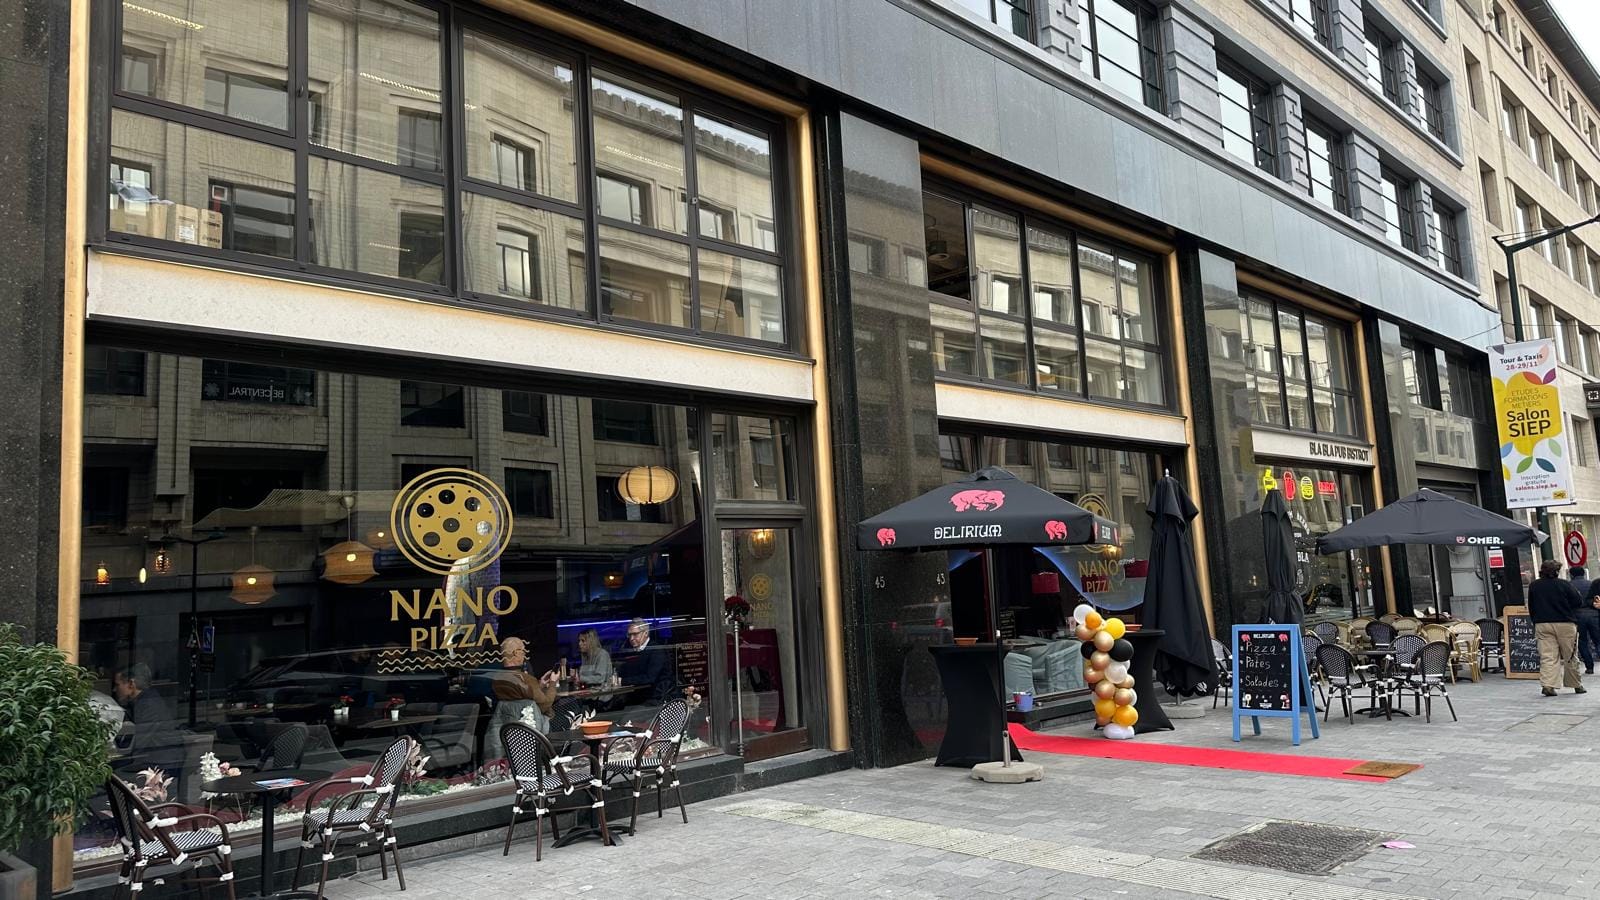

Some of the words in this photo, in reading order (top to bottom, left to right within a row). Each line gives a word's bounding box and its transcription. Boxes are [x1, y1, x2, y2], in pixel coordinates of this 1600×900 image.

[1524, 353, 1543, 361] Taxis
[1506, 361, 1538, 370] 28-29/11
[1504, 393, 1549, 404] FORMATIONS
[1506, 408, 1550, 422] Salon
[1508, 420, 1551, 438] SIEP
[1309, 442, 1322, 455] BLA
[1322, 443, 1335, 457] BLA
[1334, 445, 1347, 459] PUB
[1346, 447, 1369, 461] BISTROT
[934, 524, 1003, 540] DELIRIUM
[1078, 559, 1120, 578] NANO
[875, 576, 886, 589] 45
[936, 573, 946, 585] 43
[1086, 580, 1115, 594] PIZZA
[389, 585, 519, 621] NANO
[410, 622, 499, 652] PIZZA
[1246, 641, 1277, 654] Pizza
[1245, 675, 1279, 688] Salades
